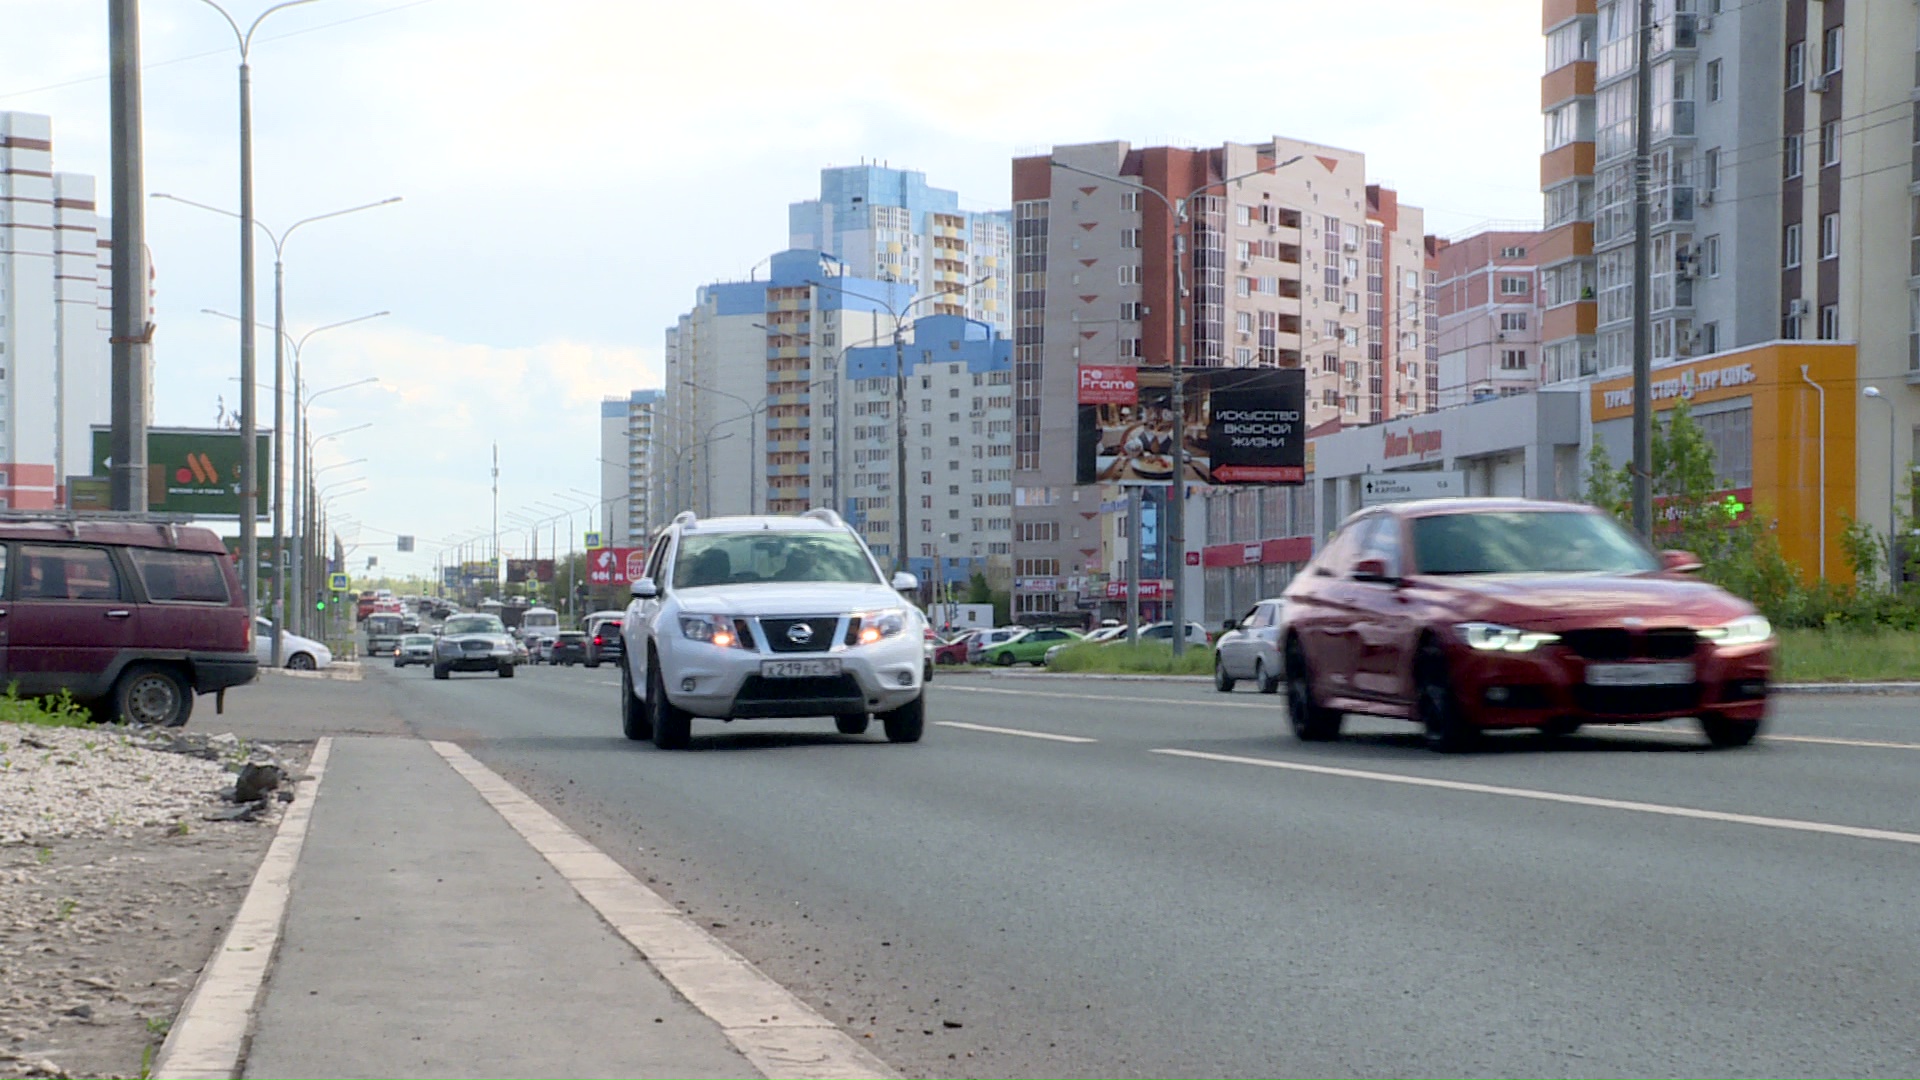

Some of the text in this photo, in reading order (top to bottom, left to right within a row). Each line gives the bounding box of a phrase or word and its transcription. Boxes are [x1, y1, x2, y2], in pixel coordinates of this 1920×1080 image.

[1604, 379, 1680, 408] ТУРАГСТВО
[1216, 411, 1299, 421] ИСКУССТВО
[1224, 423, 1291, 434] ВКУСНОЙ
[1231, 437, 1285, 447] ЖИЗНИ
[1120, 585, 1157, 595] МНИТ
